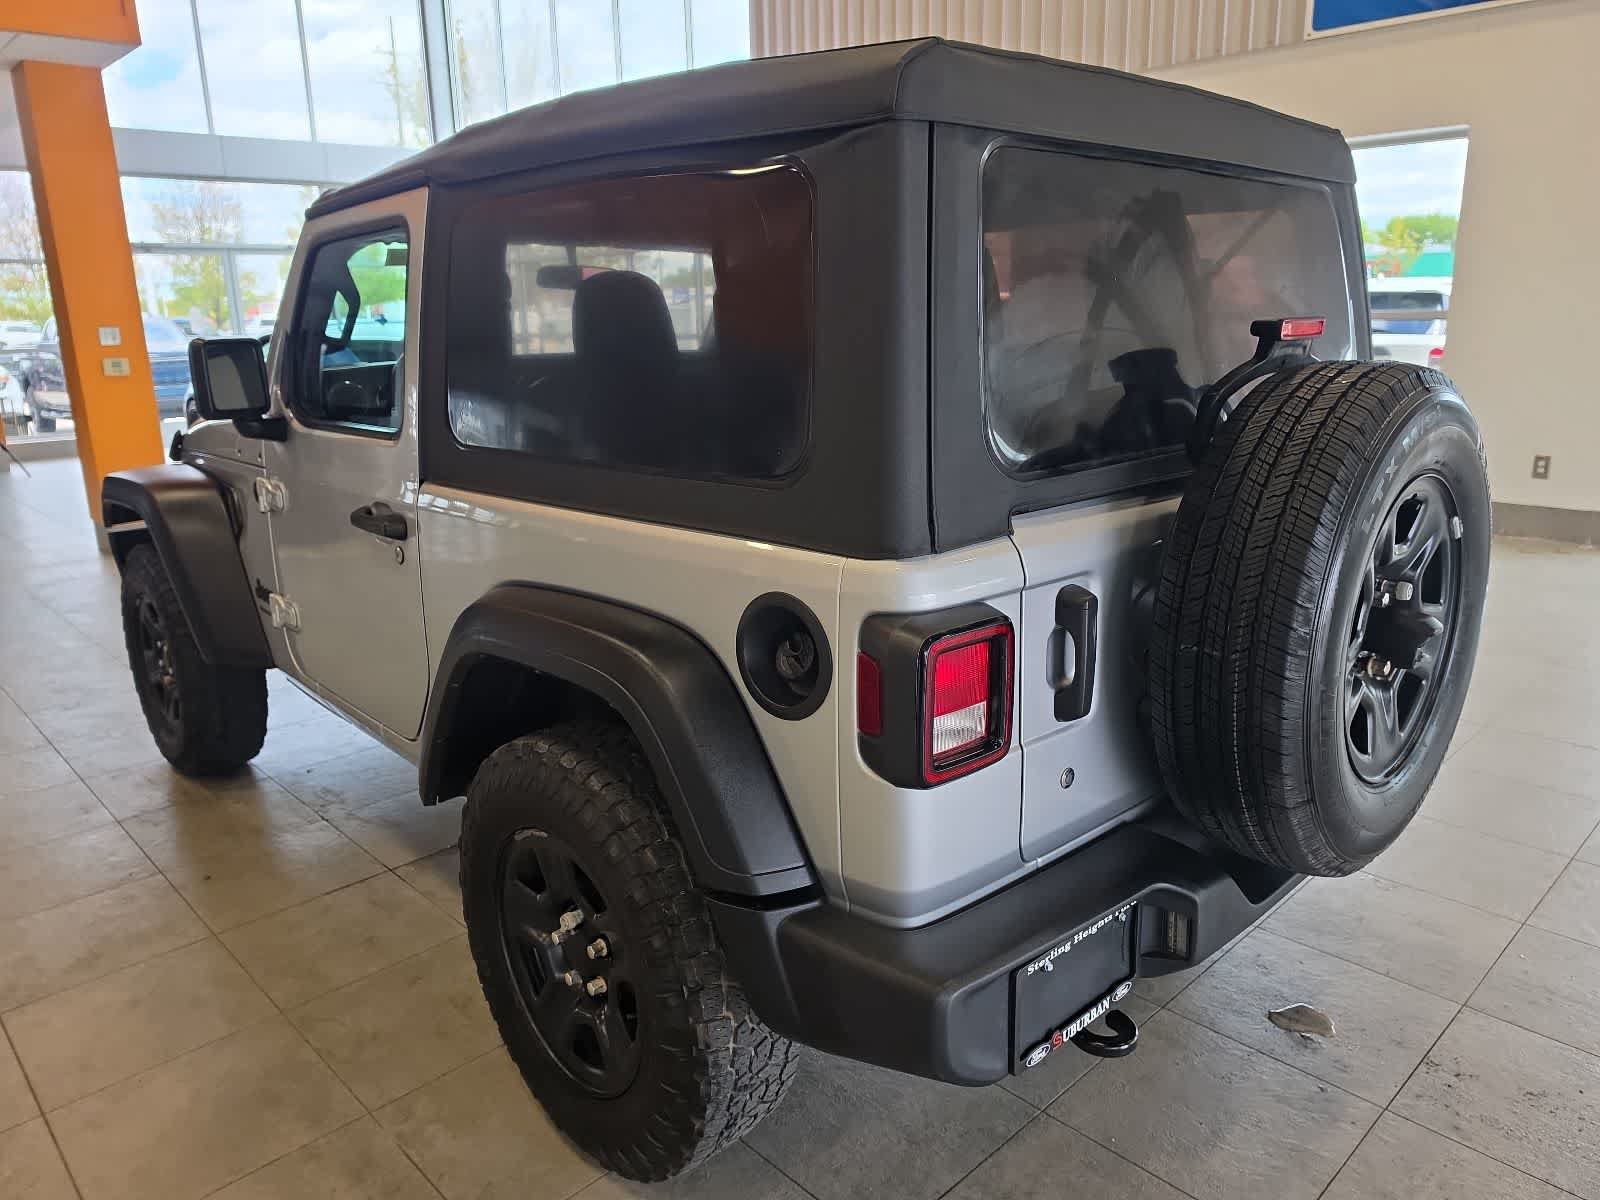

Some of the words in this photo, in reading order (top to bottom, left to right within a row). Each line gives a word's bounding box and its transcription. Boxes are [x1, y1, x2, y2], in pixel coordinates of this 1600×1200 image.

[1027, 941, 1072, 976] Sterling
[1073, 914, 1113, 945] Heights
[1052, 997, 1111, 1051] SUBURBAN
